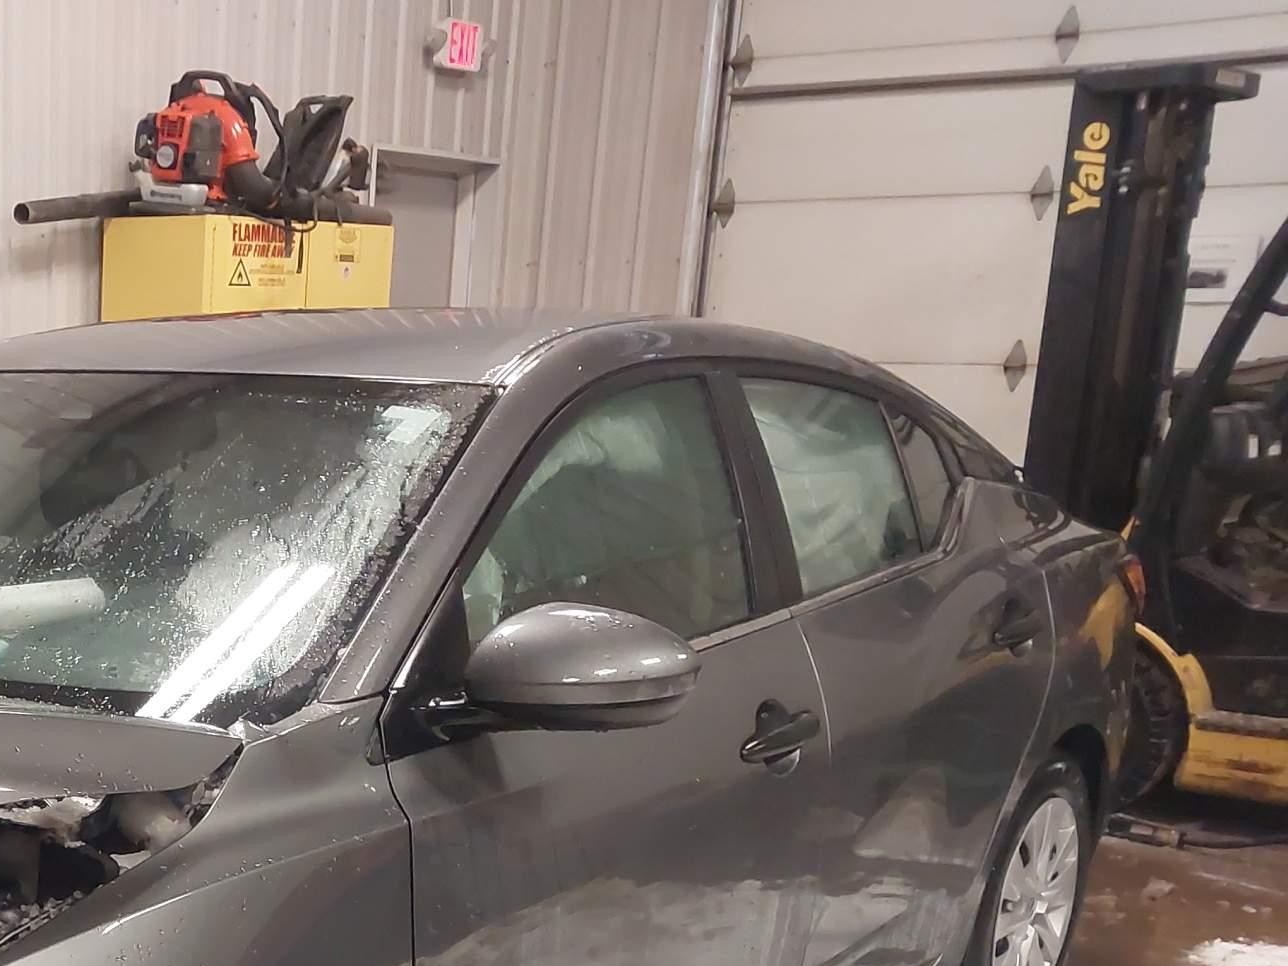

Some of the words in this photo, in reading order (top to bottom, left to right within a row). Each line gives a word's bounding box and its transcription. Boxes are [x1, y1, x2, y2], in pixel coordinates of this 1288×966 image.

[449, 22, 479, 65] EXIT
[1067, 122, 1111, 215] Yale
[232, 242, 252, 257] KEEP
[253, 243, 271, 258] FIRE
